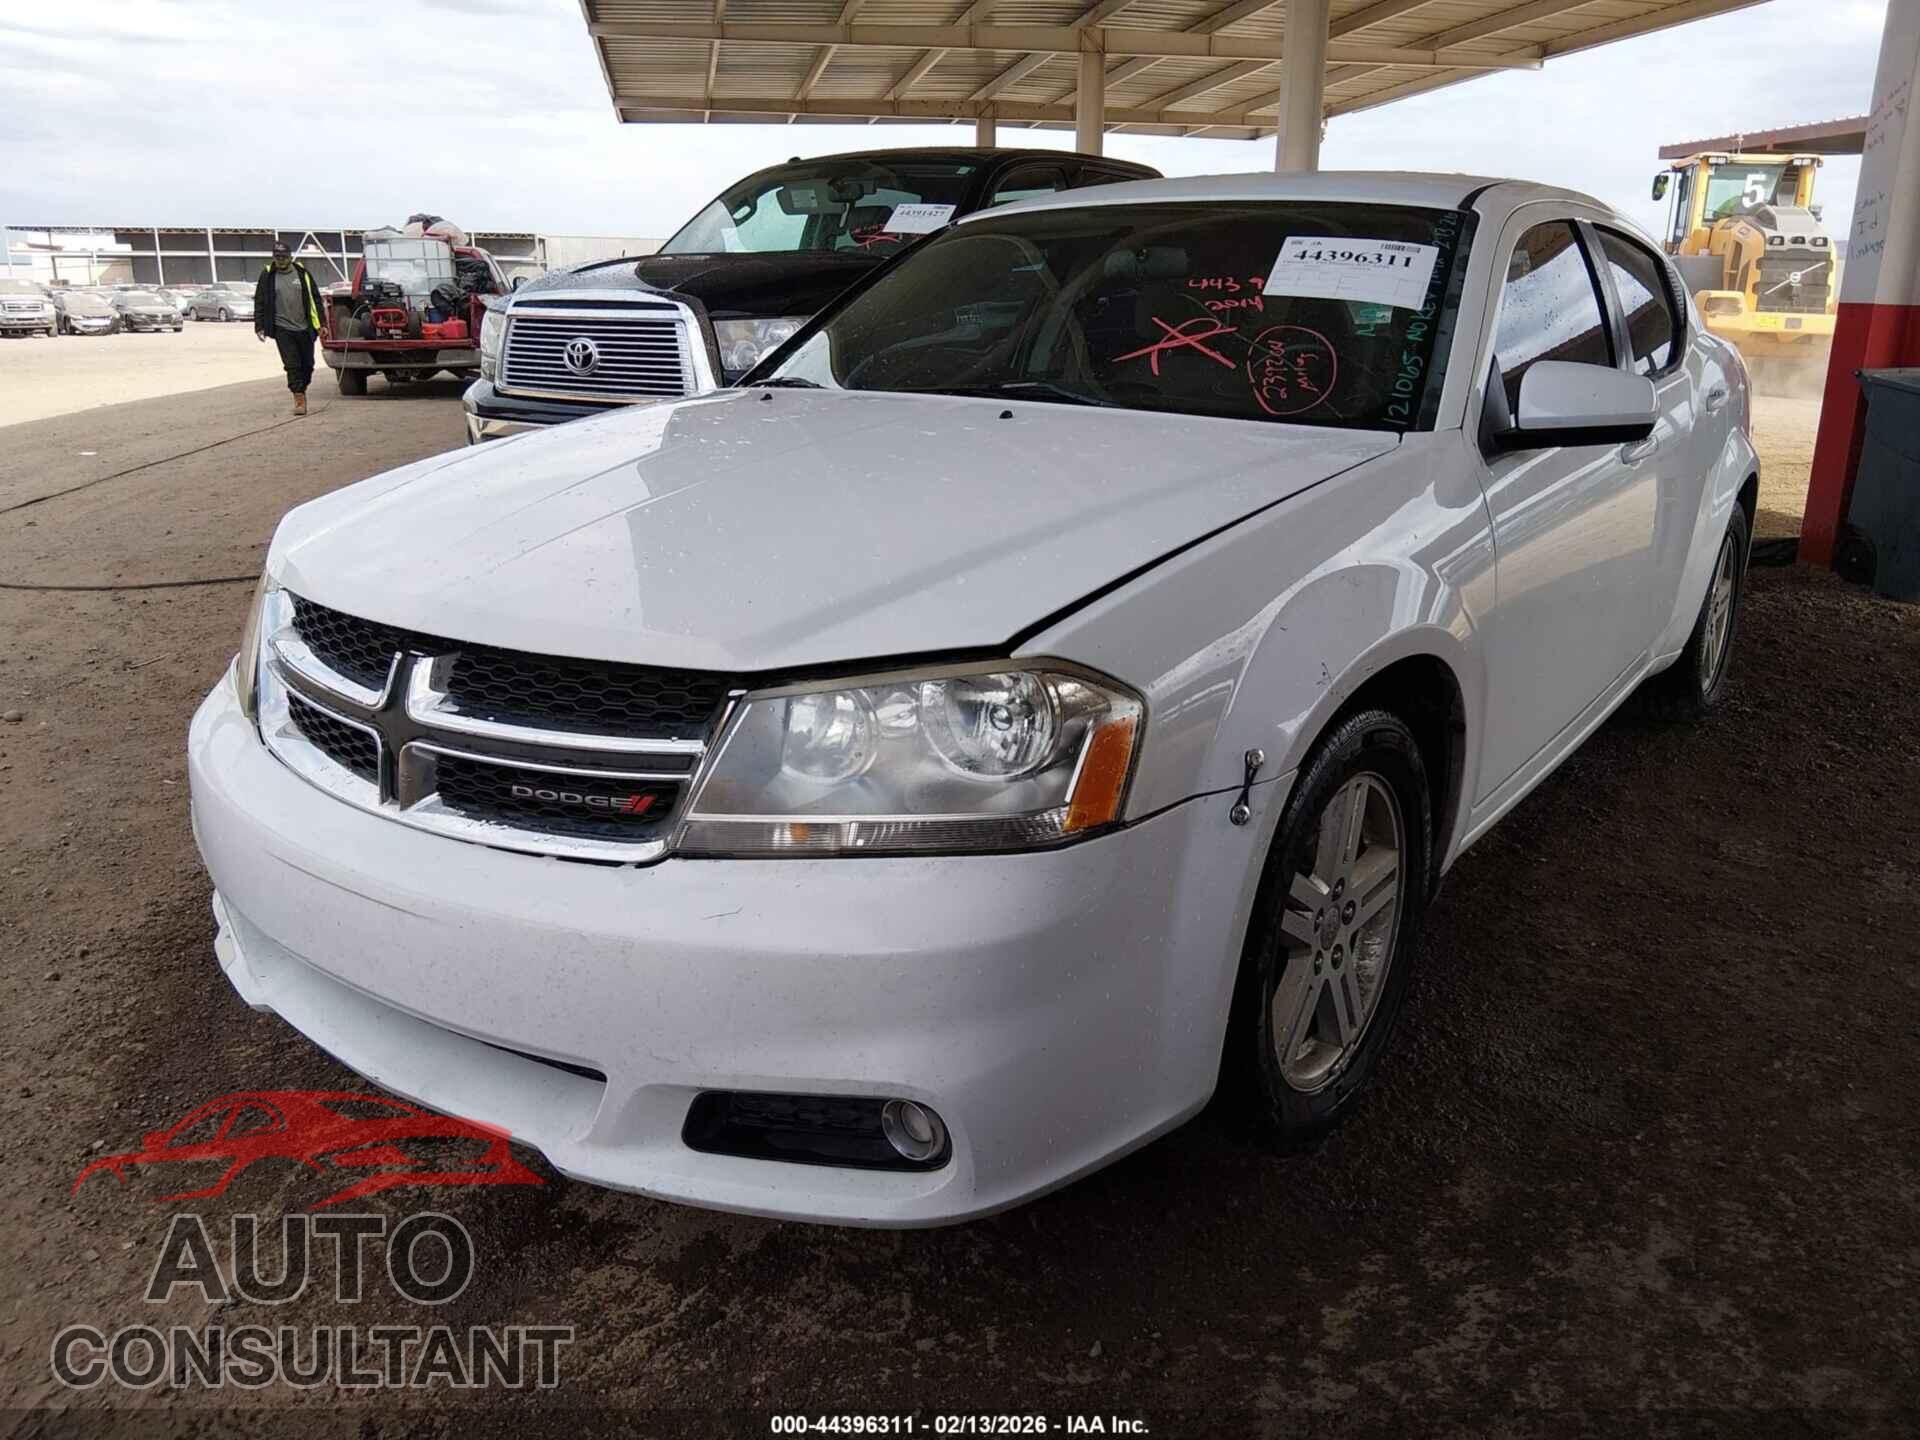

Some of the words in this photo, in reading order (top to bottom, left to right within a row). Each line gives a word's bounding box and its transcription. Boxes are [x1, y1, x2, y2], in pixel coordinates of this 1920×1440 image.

[1742, 173, 1766, 208] 5
[1293, 249, 1413, 268] 44396311
[1204, 295, 1264, 312] 2014
[512, 785, 633, 808] DODGE
